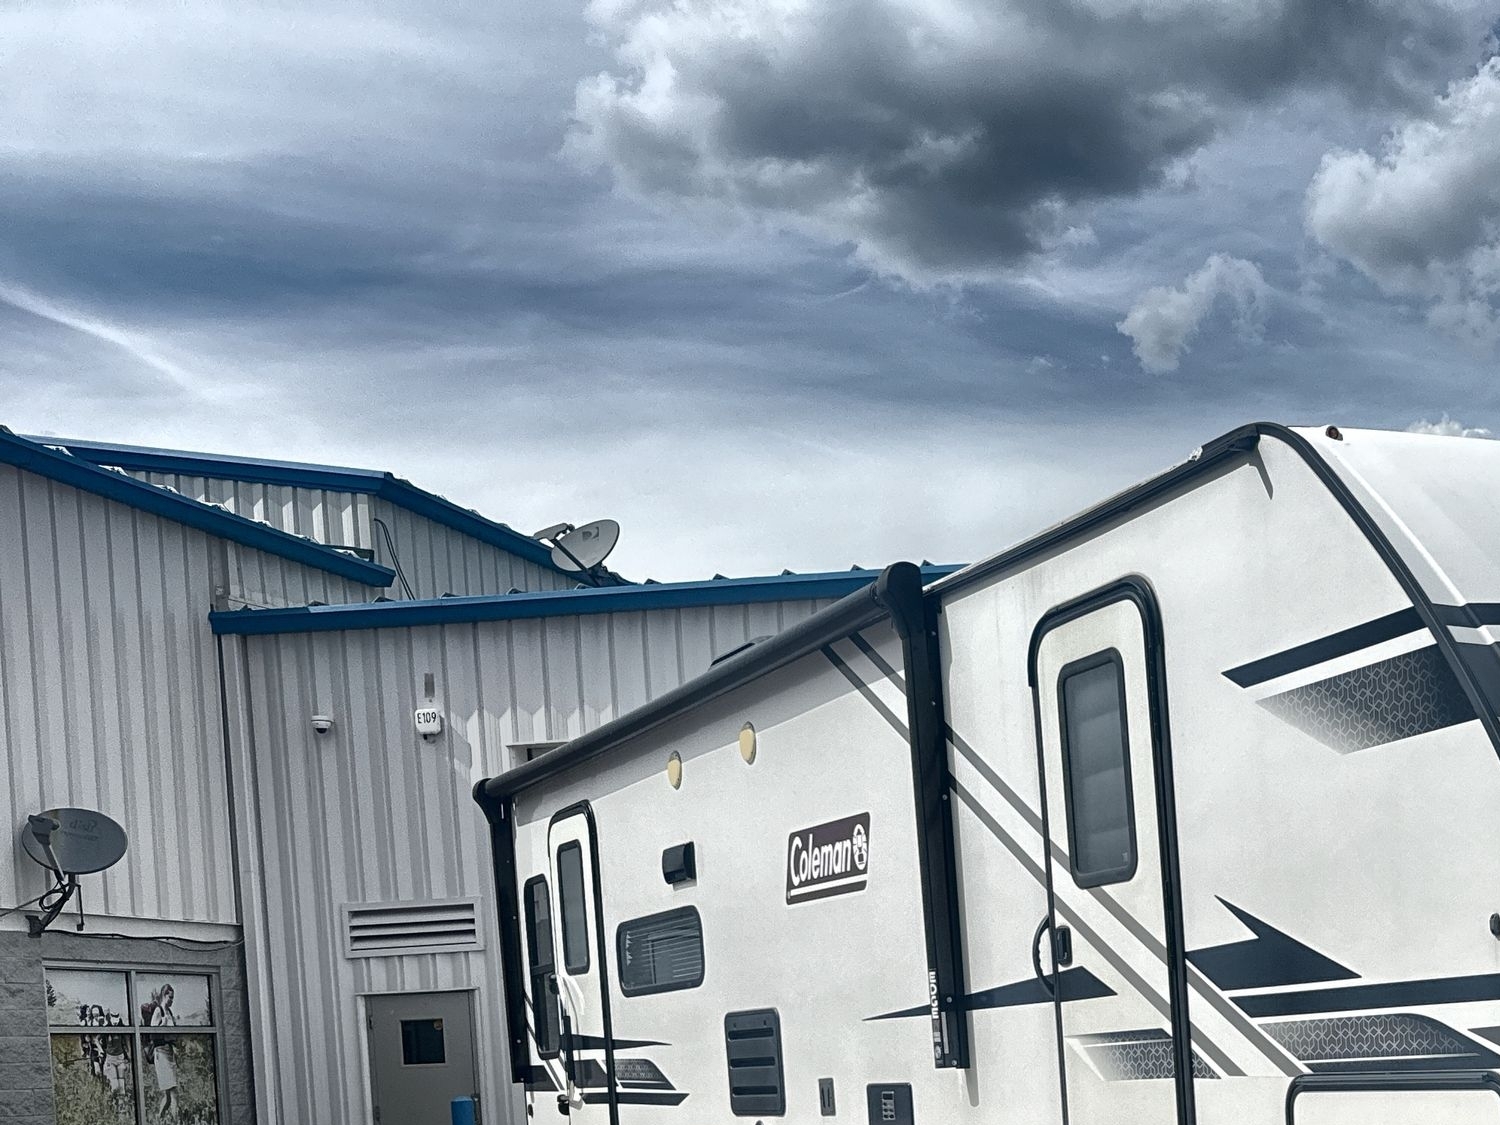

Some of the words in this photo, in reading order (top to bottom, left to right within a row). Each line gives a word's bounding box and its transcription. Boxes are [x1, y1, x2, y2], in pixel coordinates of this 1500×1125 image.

[417, 711, 437, 724] E109
[790, 833, 852, 887] Coleman
[928, 970, 940, 1020] EDGE
